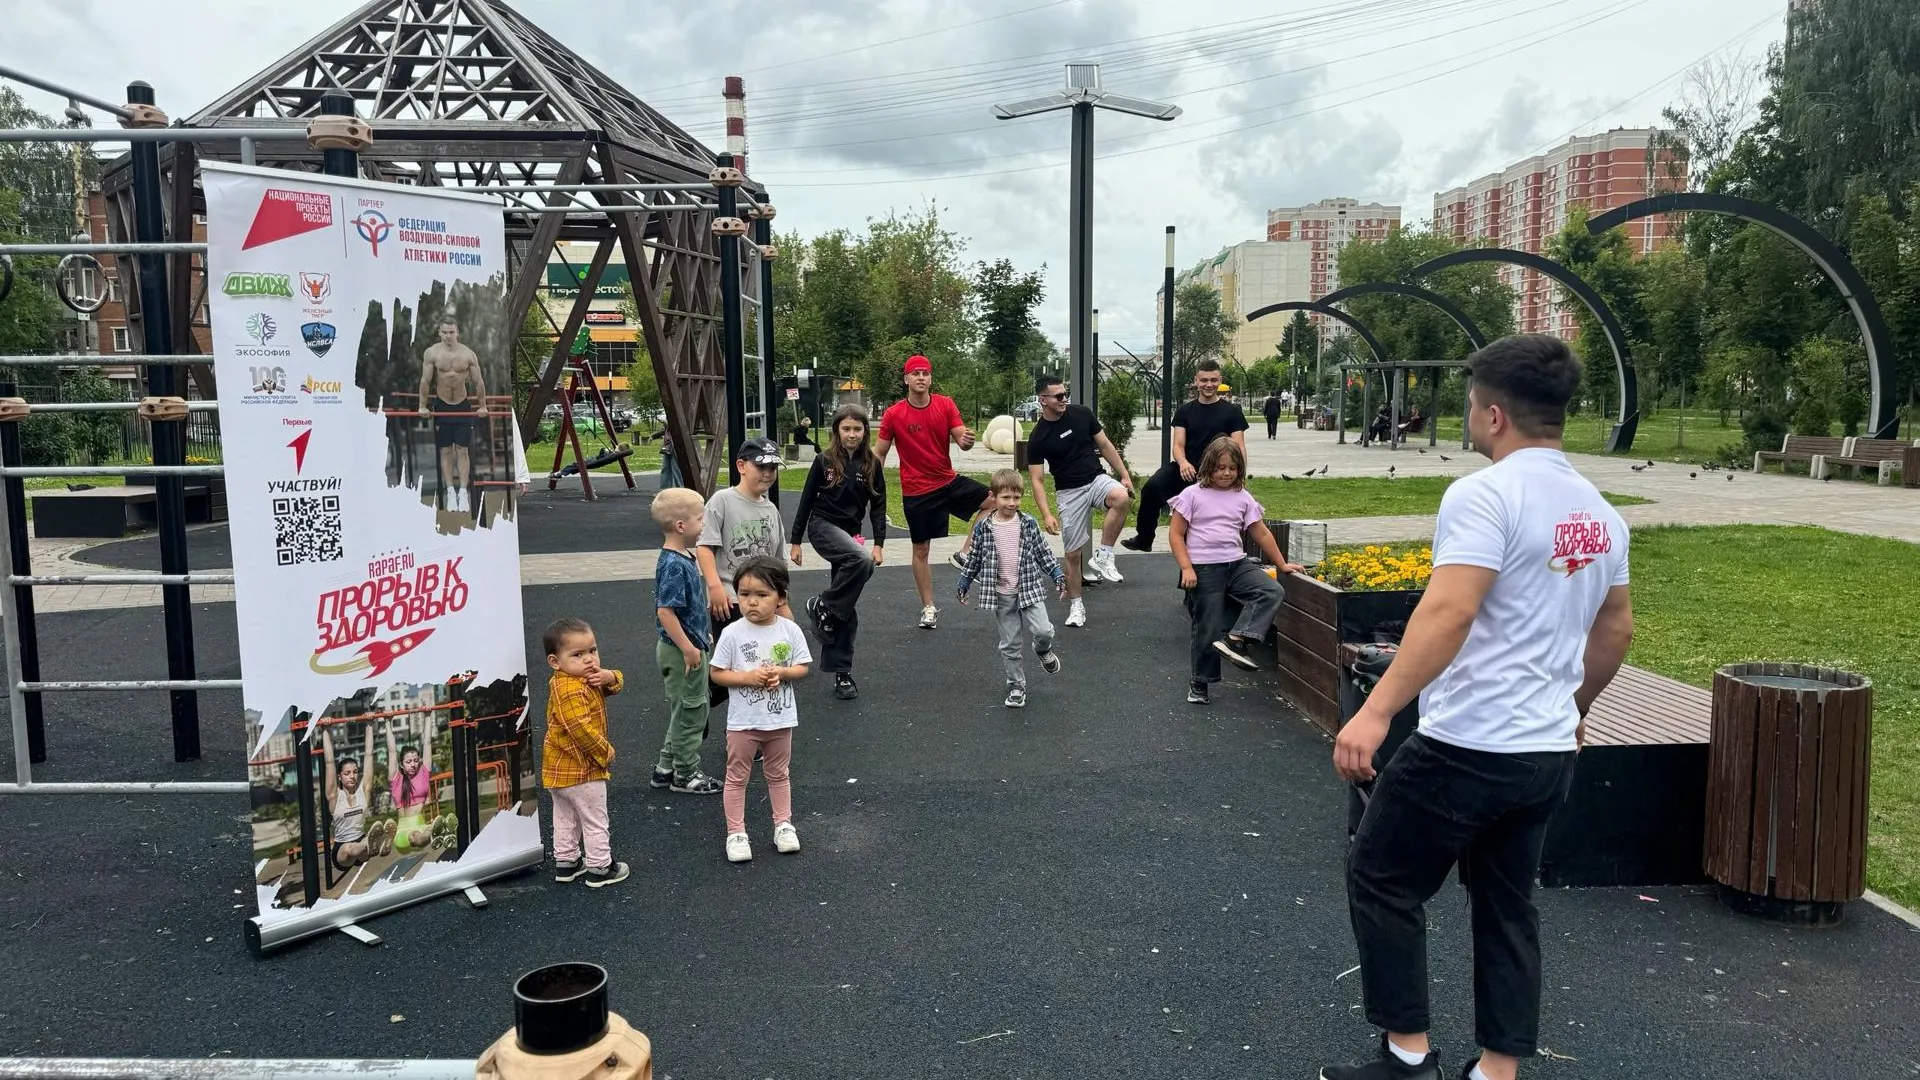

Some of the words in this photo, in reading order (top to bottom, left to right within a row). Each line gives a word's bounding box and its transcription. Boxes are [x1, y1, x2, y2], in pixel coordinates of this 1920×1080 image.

[268, 190, 330, 206] НАЦИОНАЛЬНЫЕ
[358, 198, 384, 209] ПАРТНЕР
[296, 203, 331, 215] ПРОЕКТЫ
[303, 212, 331, 224] РОССИИ
[398, 218, 446, 233] ФЕДЕРАЦИЯ
[400, 230, 481, 249] ВОЗДУШНО-СИЛОВОЙ
[404, 248, 447, 264] АТЛЕТИКИ
[449, 252, 482, 267] РОССИИ
[223, 274, 294, 298] ДВИЖ
[236, 349, 291, 357] ЭКОСОФИЯ
[313, 382, 342, 393] РССМ
[282, 418, 313, 428] Первые
[268, 477, 342, 493] УЧАСТВУЙ!
[1554, 522, 1601, 542] ПРОРЫВ
[1602, 522, 1610, 541] К
[1552, 537, 1612, 559] ЗДОРОВЬЮ
[317, 563, 440, 624] ПРОРЫВ
[444, 556, 464, 587] К
[314, 582, 469, 655] ЗДОРОВЬЮ
